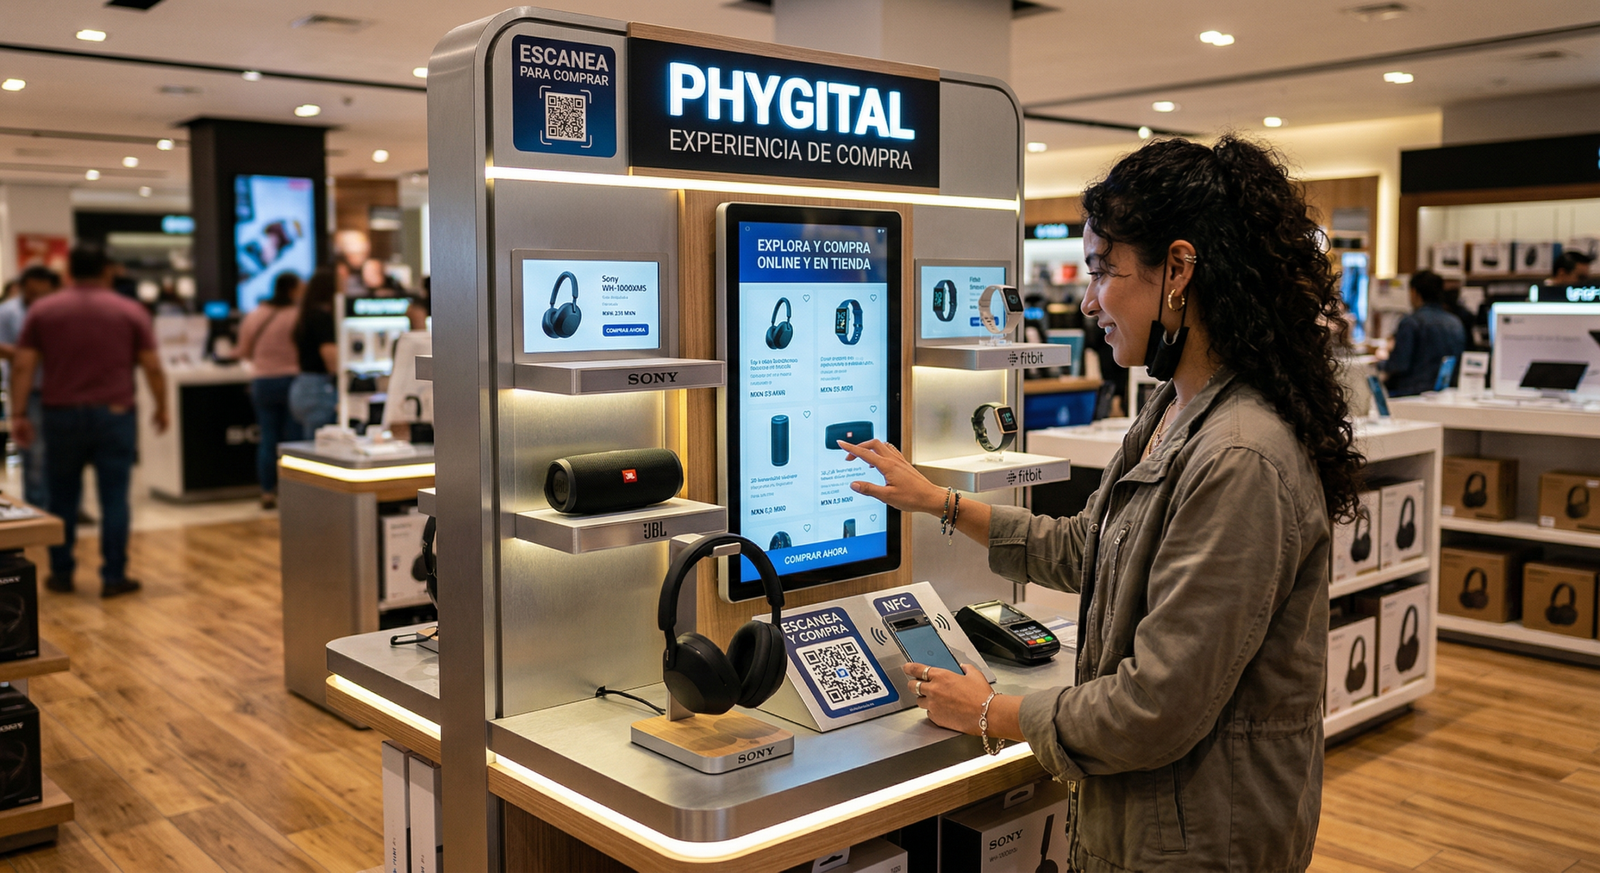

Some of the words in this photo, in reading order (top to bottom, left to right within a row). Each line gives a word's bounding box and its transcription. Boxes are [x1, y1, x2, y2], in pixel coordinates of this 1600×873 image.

[519, 44, 610, 72] ESCANEA
[519, 65, 551, 80] PARA
[553, 70, 610, 87] COMPRAR
[669, 61, 916, 141] PHYGITAL
[669, 128, 803, 160] EXPERIENCIA
[807, 142, 833, 162] DE
[836, 145, 913, 170] COMPRA
[757, 239, 811, 252] EXPLORA
[813, 241, 821, 252] Y
[823, 241, 871, 254] COMPRA
[757, 256, 801, 269] ONLINE
[804, 257, 811, 268] Y
[813, 257, 829, 269] EN
[831, 258, 871, 270] TIENDA
[602, 275, 619, 284] Sony
[1020, 352, 1044, 365] fitbit
[628, 372, 678, 385] SONY
[1018, 468, 1042, 483] fitbit
[555, 479, 567, 493] JBL
[643, 521, 667, 539] JBL
[784, 551, 822, 565] COMPRAR
[822, 547, 848, 558] AHORA
[882, 597, 912, 613] NFC
[781, 612, 843, 634] ESCANEA
[787, 635, 797, 645] Y
[799, 623, 850, 643] COMPRA
[738, 746, 775, 764] SONY
[989, 829, 1024, 850] SONY
